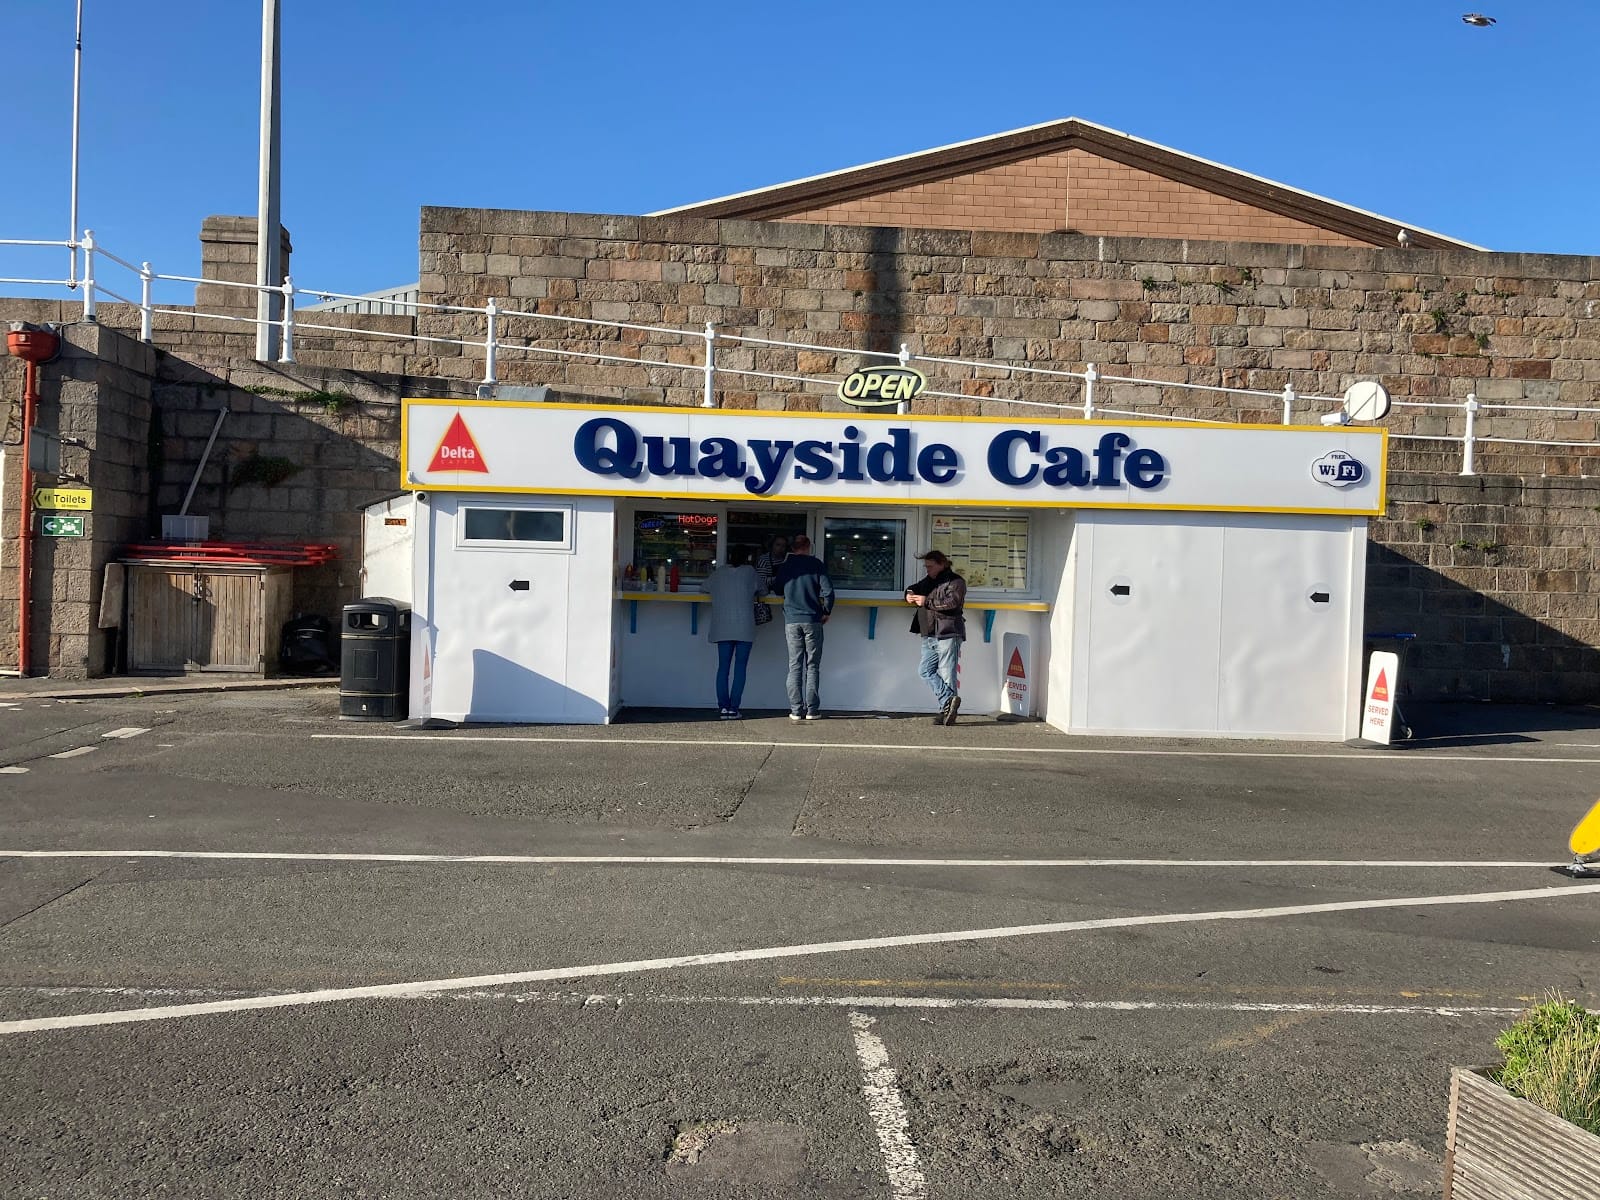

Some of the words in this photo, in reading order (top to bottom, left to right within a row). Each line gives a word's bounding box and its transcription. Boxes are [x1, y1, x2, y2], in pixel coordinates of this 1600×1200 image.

[844, 373, 917, 399] OPEN
[441, 445, 475, 459] Delta
[573, 417, 959, 494] Quayside
[987, 429, 1165, 488] Cafe
[53, 494, 87, 504] Toilets
[1367, 704, 1389, 716] SERVED
[1369, 716, 1385, 727] HERE
